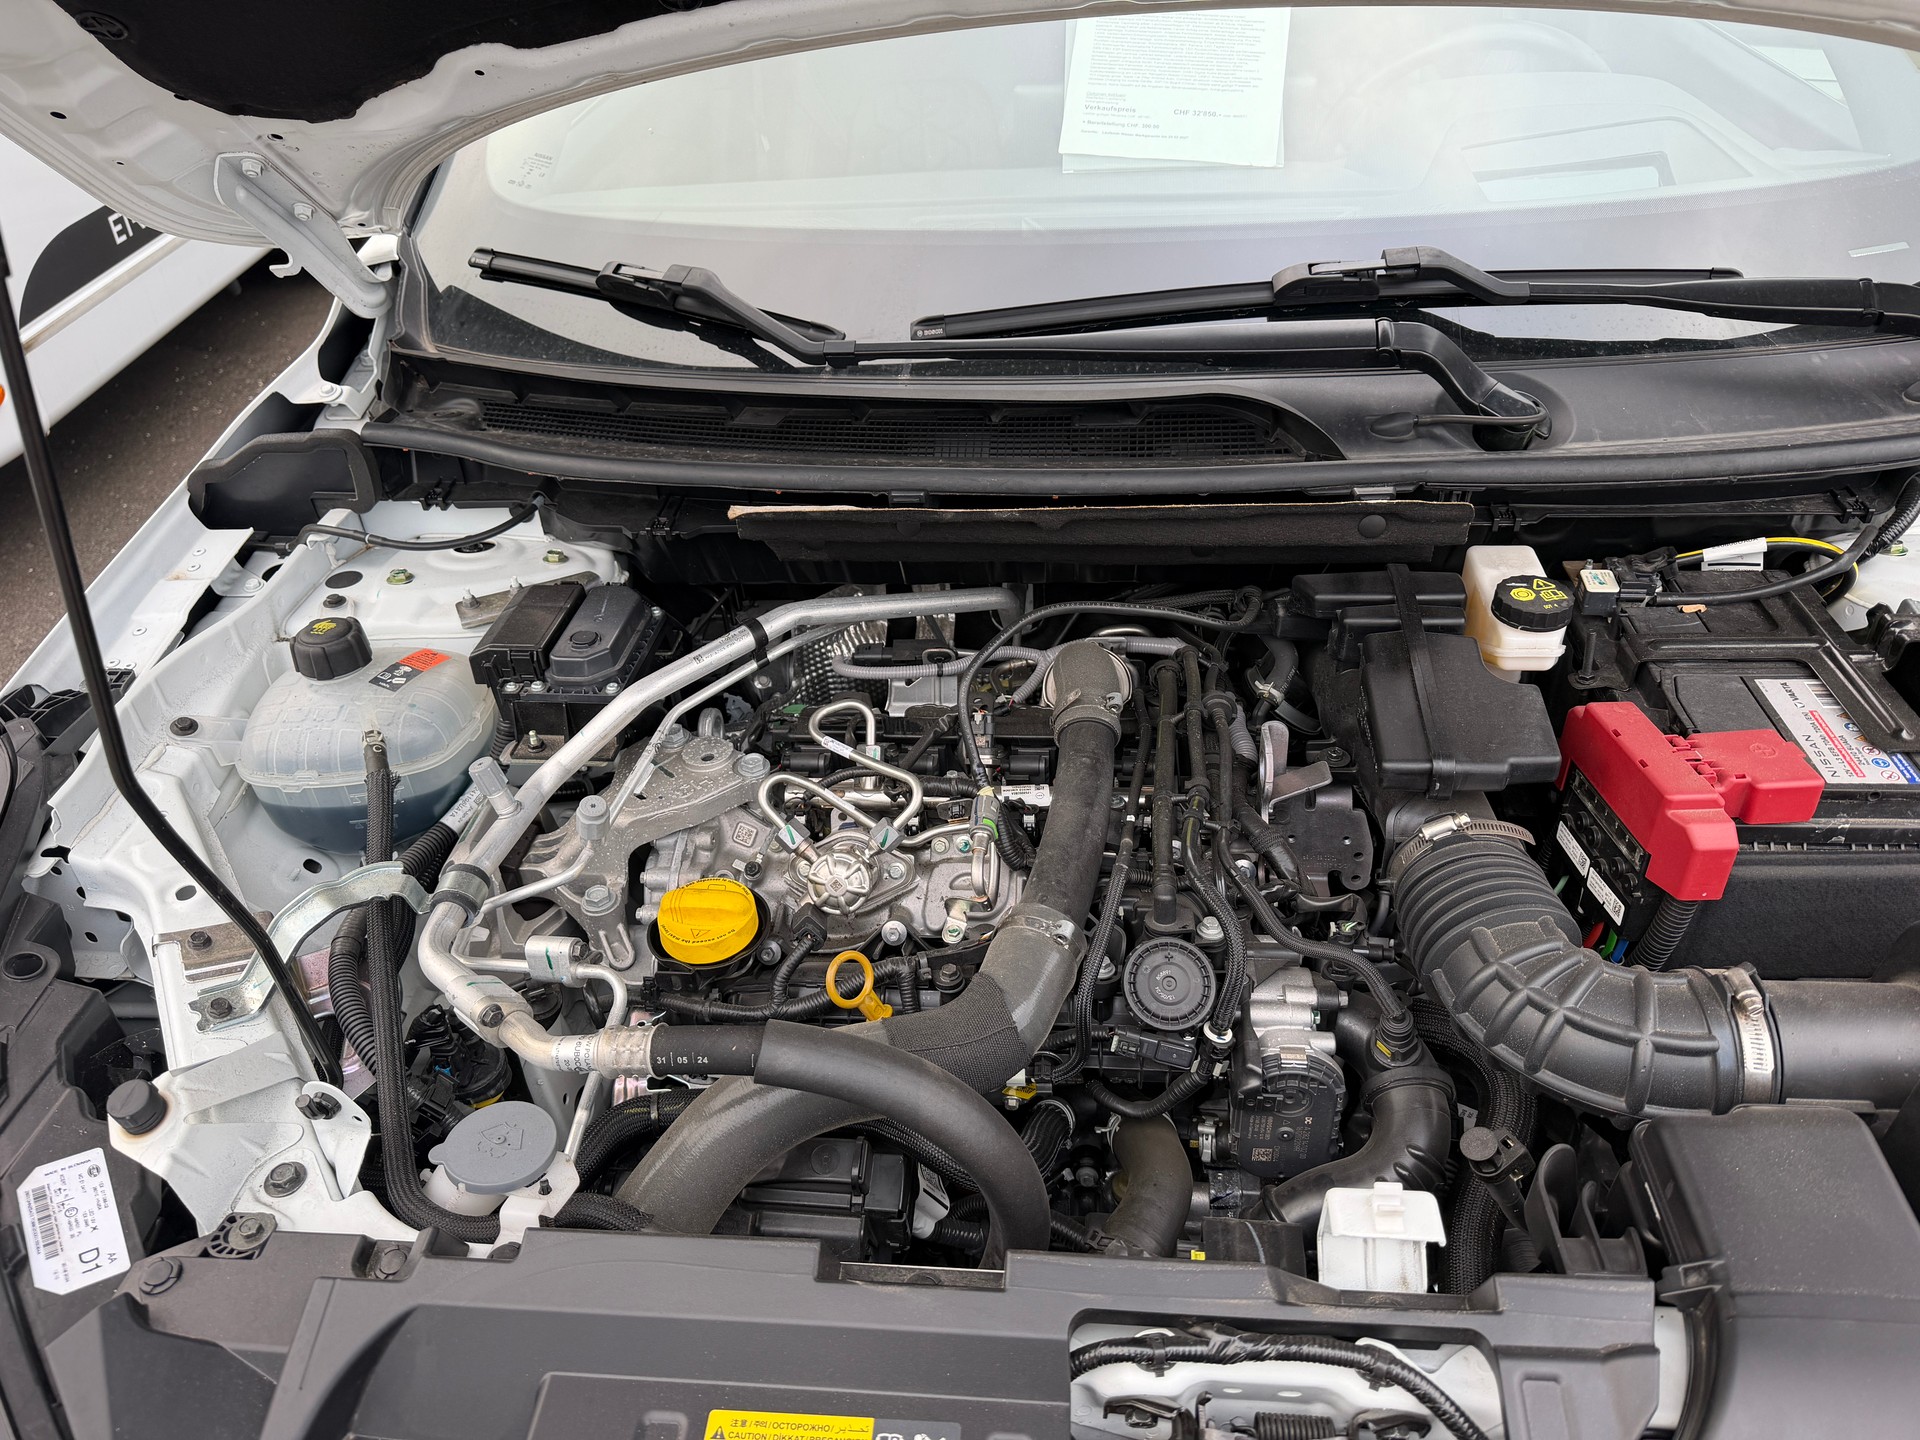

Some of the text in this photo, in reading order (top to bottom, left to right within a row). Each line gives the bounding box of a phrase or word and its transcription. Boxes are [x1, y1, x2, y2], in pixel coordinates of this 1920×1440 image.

[1084, 104, 1136, 113] Verkaufspreis
[1173, 108, 1190, 116] CHF
[1778, 682, 1800, 701] VARTA
[1801, 734, 1841, 777] NISSAN
[656, 1056, 709, 1064] 31 05 24
[1304, 1116, 1312, 1125] DC
[78, 1247, 102, 1274] D1
[107, 1252, 117, 1264] AA
[730, 1418, 748, 1428] 注意
[772, 1422, 830, 1432] ОСТОРОЖНО
[728, 1431, 768, 1440] CAUTION
